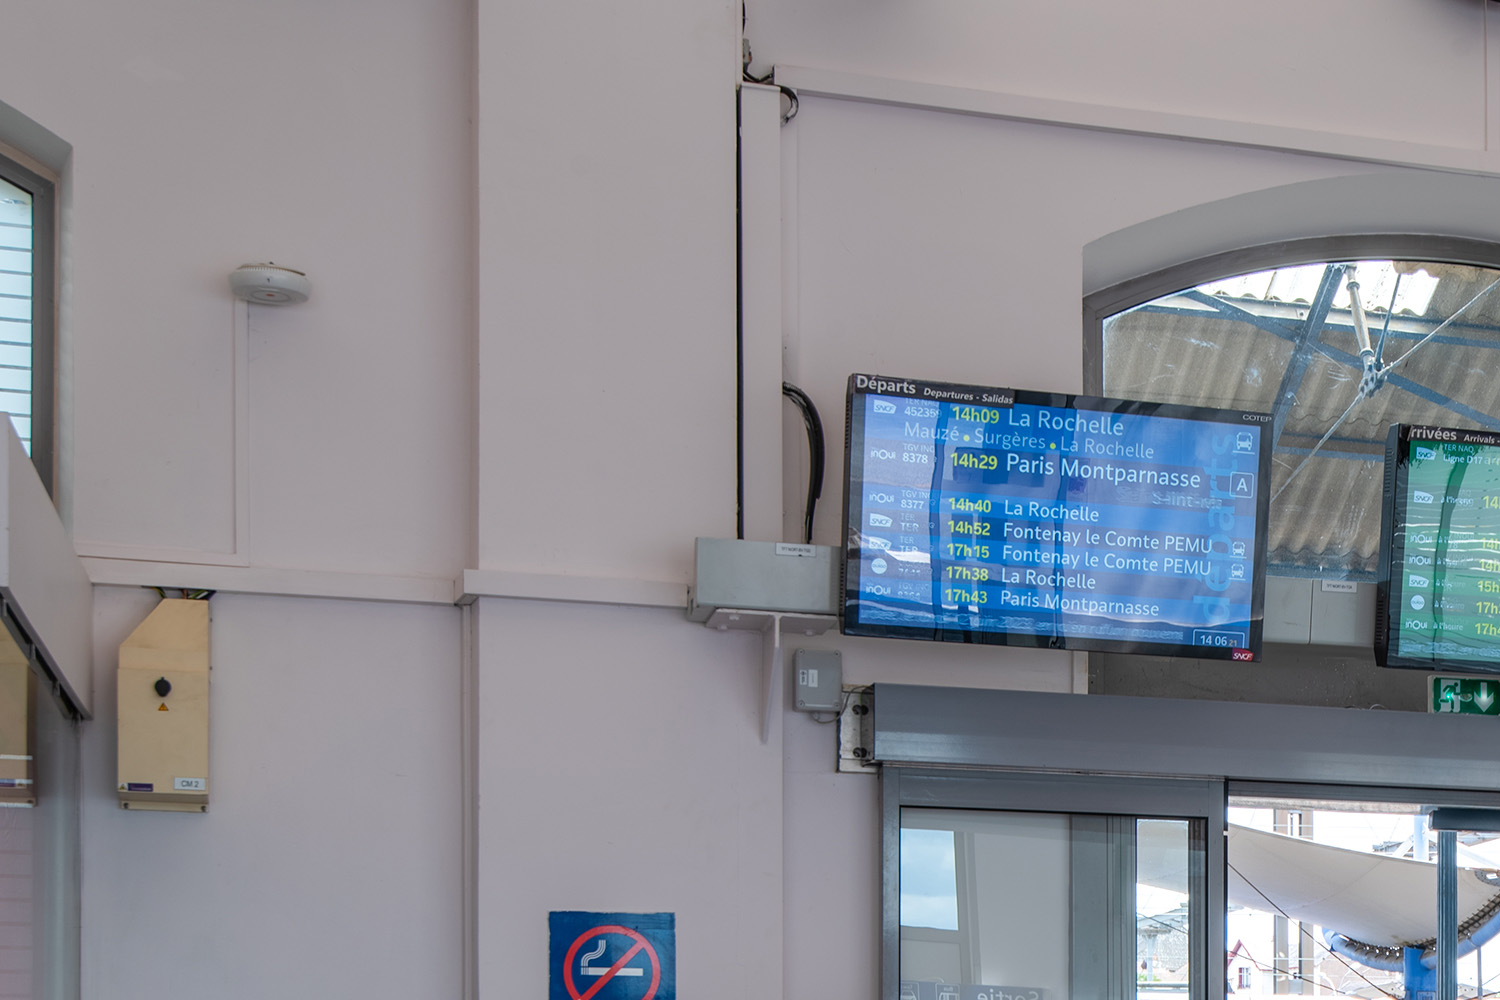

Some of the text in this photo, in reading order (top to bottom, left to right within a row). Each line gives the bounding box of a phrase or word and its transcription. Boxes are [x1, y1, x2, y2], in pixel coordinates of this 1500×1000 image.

[856, 375, 916, 394] Départs
[924, 388, 1013, 404] Departures Salidas
[952, 407, 999, 423] 14h09
[1008, 408, 1124, 437] La Rochelle
[1243, 414, 1272, 422] COTEP
[904, 422, 1154, 459] Mauzé Surgères La Rochelle
[1464, 435, 1495, 444] Arrivals
[902, 452, 928, 464] 8378
[951, 453, 998, 470] 14h29
[1443, 454, 1465, 464] Ligne
[1006, 453, 1201, 489] Paris Montparnasse
[901, 500, 924, 509] 8377
[949, 497, 991, 513] 14h40
[1004, 500, 1100, 523] La Rochelle
[948, 520, 991, 536] 14h52
[1003, 522, 1213, 554] Fontenay le Comte PEMU
[947, 543, 989, 559] 17h15
[1002, 545, 1211, 576] Fontenay le Comte PEMU
[946, 566, 989, 581] 17h38
[1001, 568, 1096, 590] La Rochelle
[945, 589, 987, 604] 17h43
[1001, 591, 1160, 617] Paris Montparnasse
